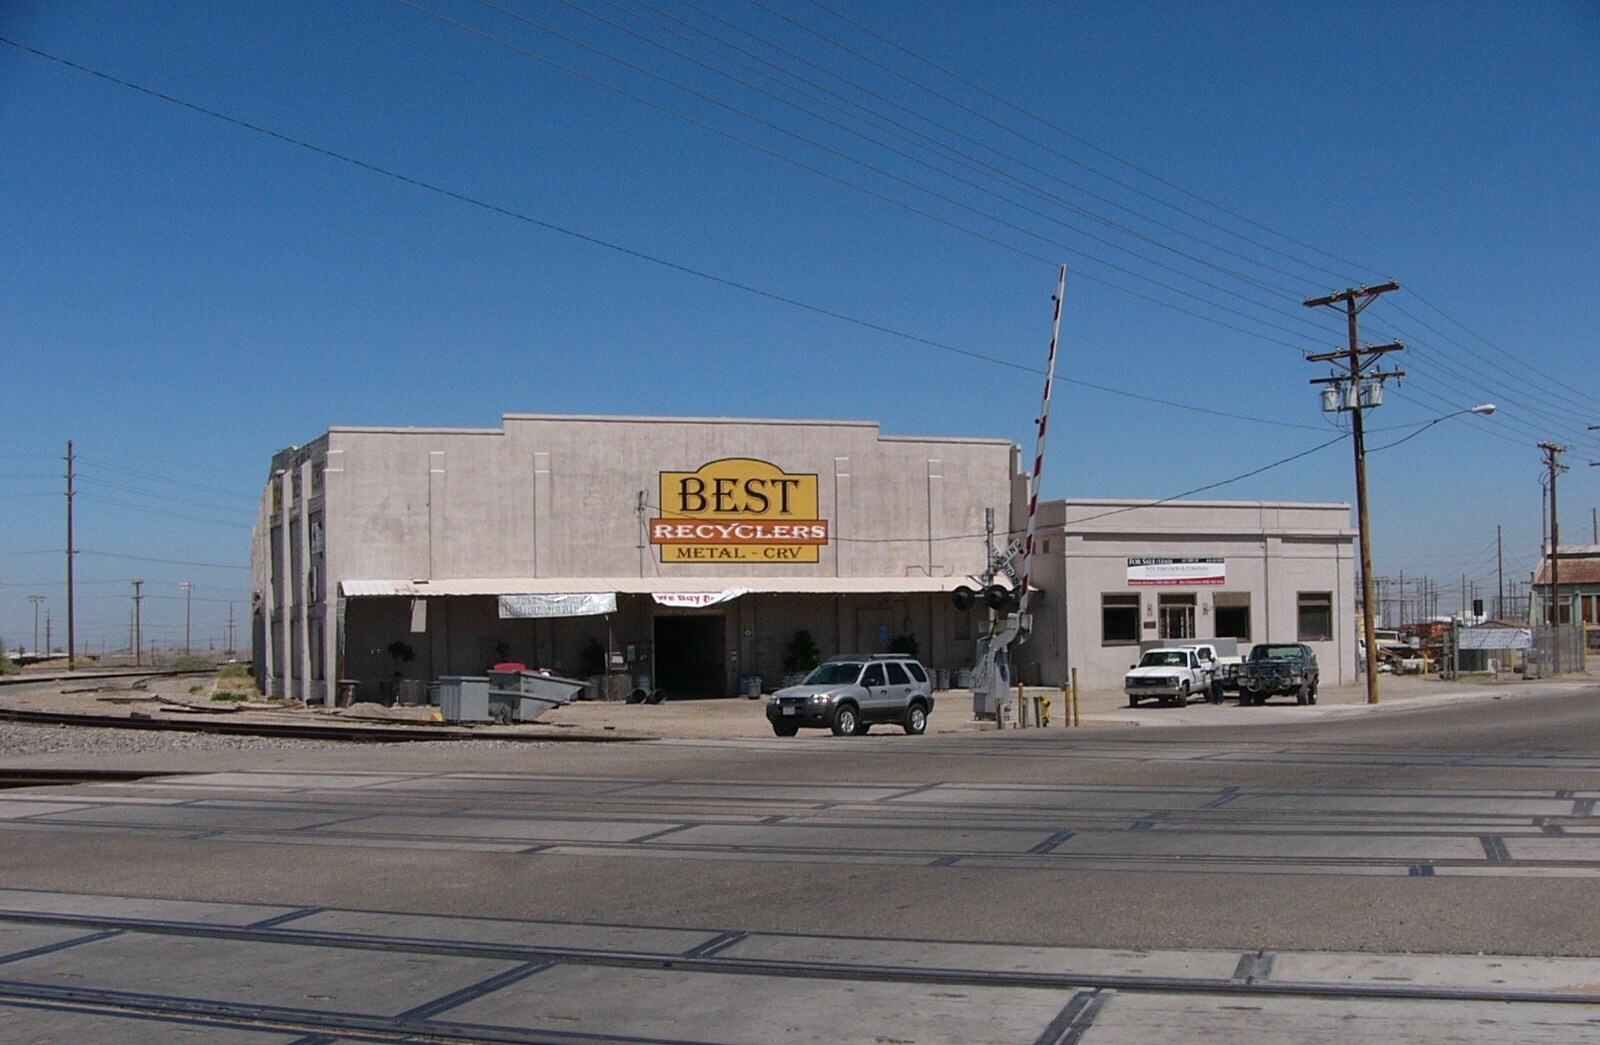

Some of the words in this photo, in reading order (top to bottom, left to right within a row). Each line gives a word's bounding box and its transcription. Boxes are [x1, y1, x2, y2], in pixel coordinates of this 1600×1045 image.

[678, 477, 800, 515] BEST
[653, 523, 827, 540] RECYCLERS
[677, 547, 745, 559] METAL
[763, 547, 802, 559] CRV
